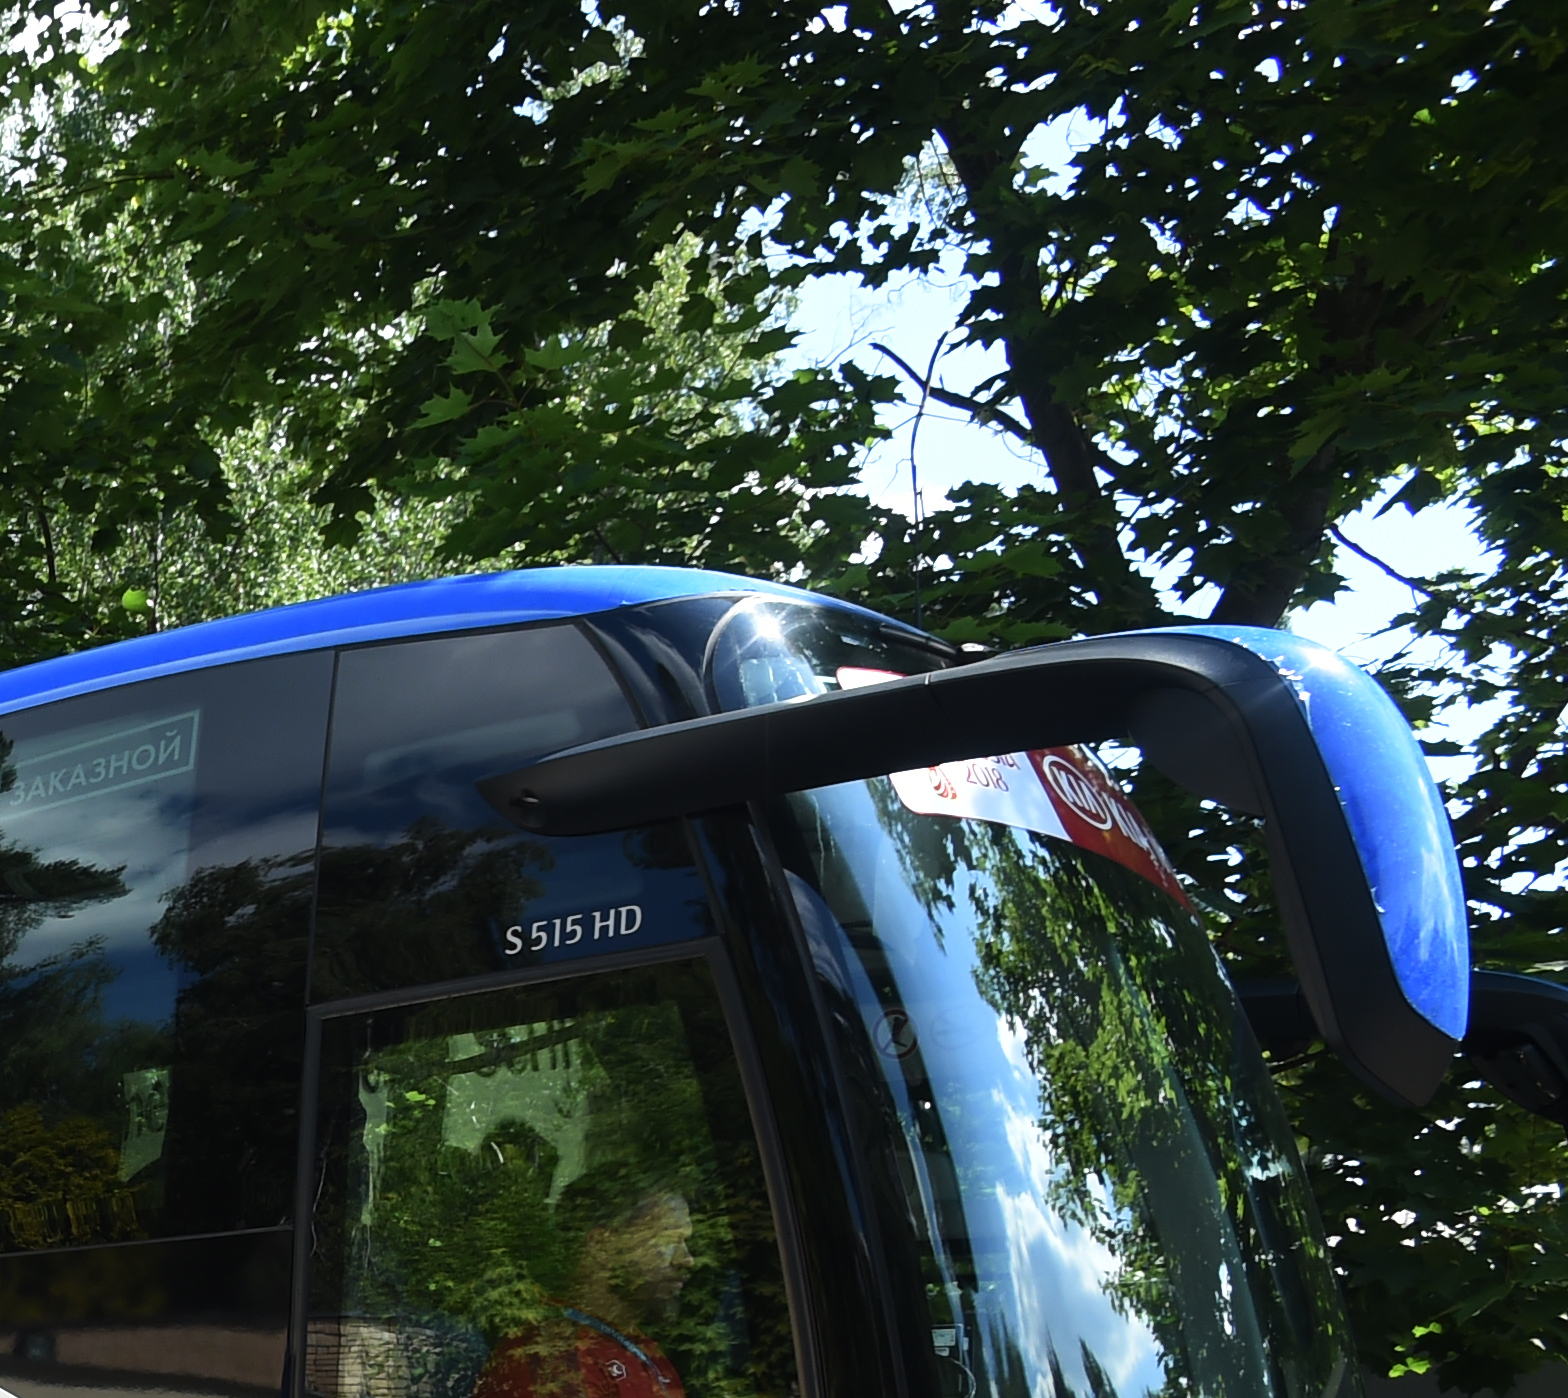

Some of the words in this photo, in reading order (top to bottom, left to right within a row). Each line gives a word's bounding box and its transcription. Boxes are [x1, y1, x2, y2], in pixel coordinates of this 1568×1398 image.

[10, 730, 181, 807] ЗАКАЗНОЙ
[504, 925, 523, 955] S
[530, 914, 583, 951] 515
[591, 905, 642, 940] HD
